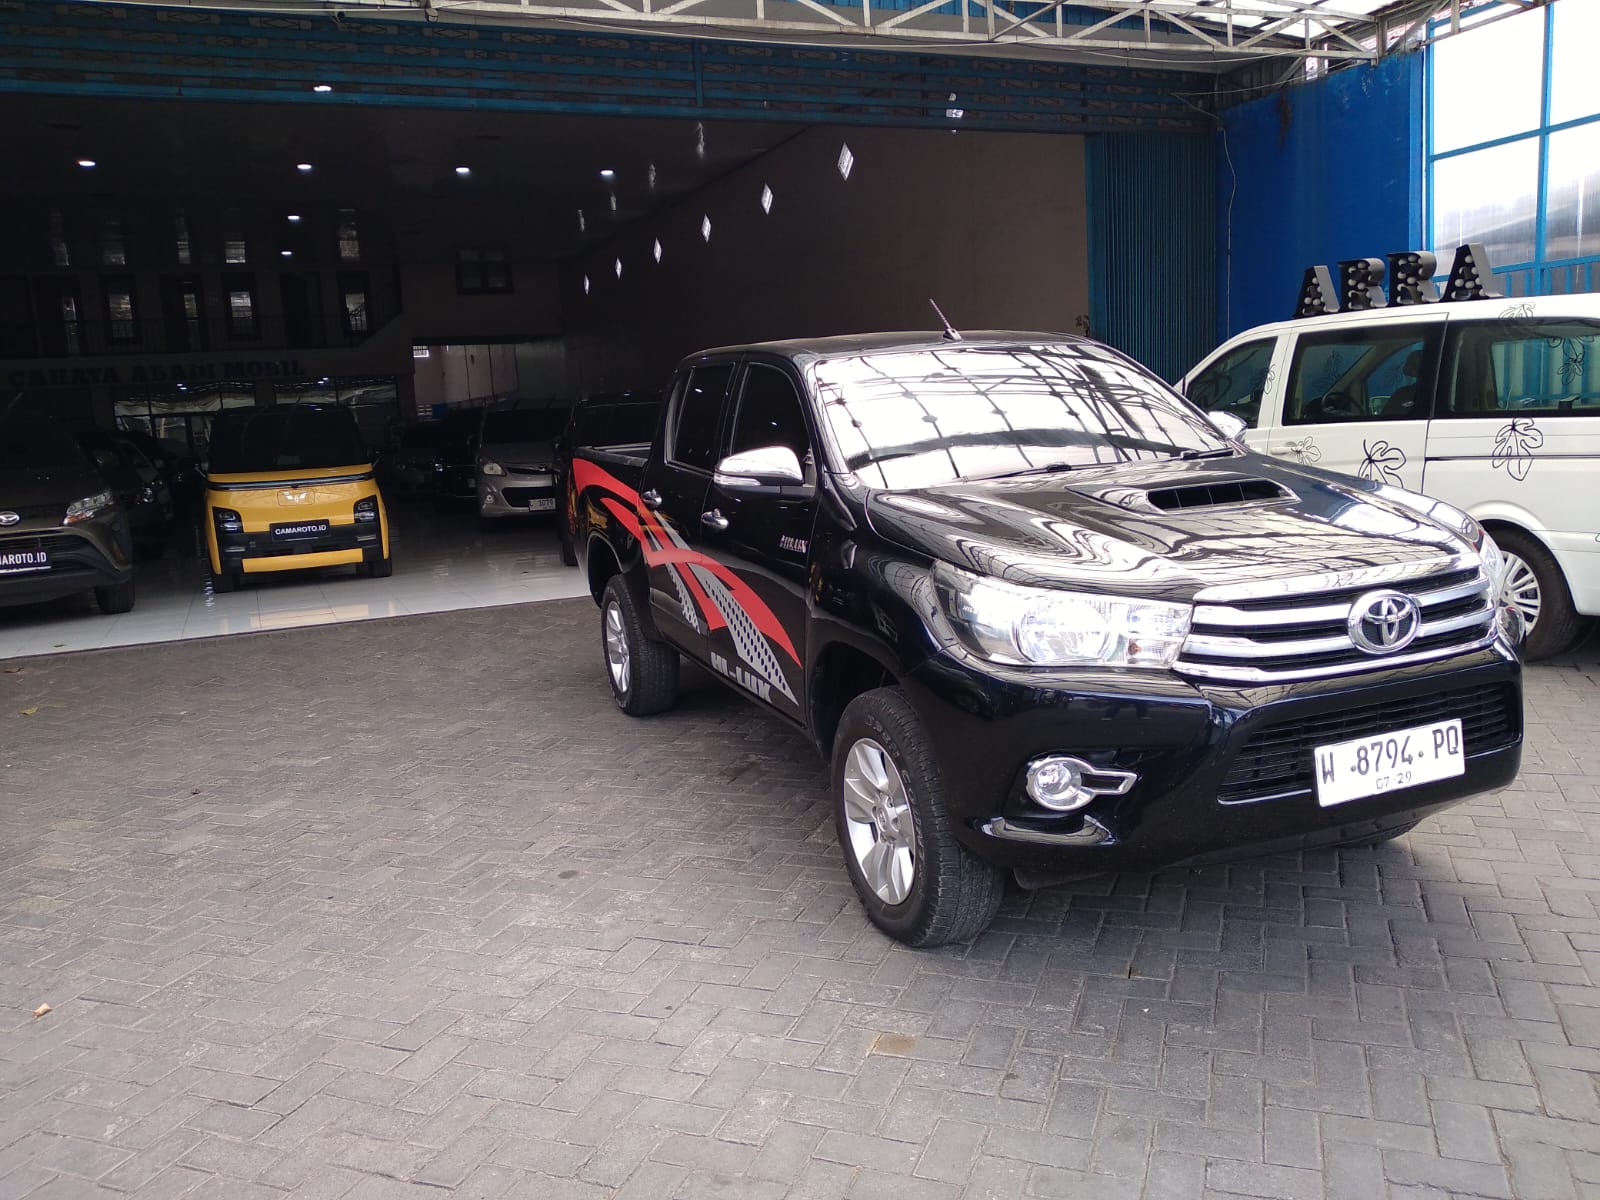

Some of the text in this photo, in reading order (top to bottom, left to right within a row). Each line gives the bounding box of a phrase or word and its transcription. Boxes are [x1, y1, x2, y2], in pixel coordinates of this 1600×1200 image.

[8, 359, 305, 388] CAHAYA ABADI MOBIL
[275, 525, 327, 535] CAMAROTO.ID
[0, 552, 47, 566] AROTO.ID
[1321, 726, 1460, 784] W 8794 PQ
